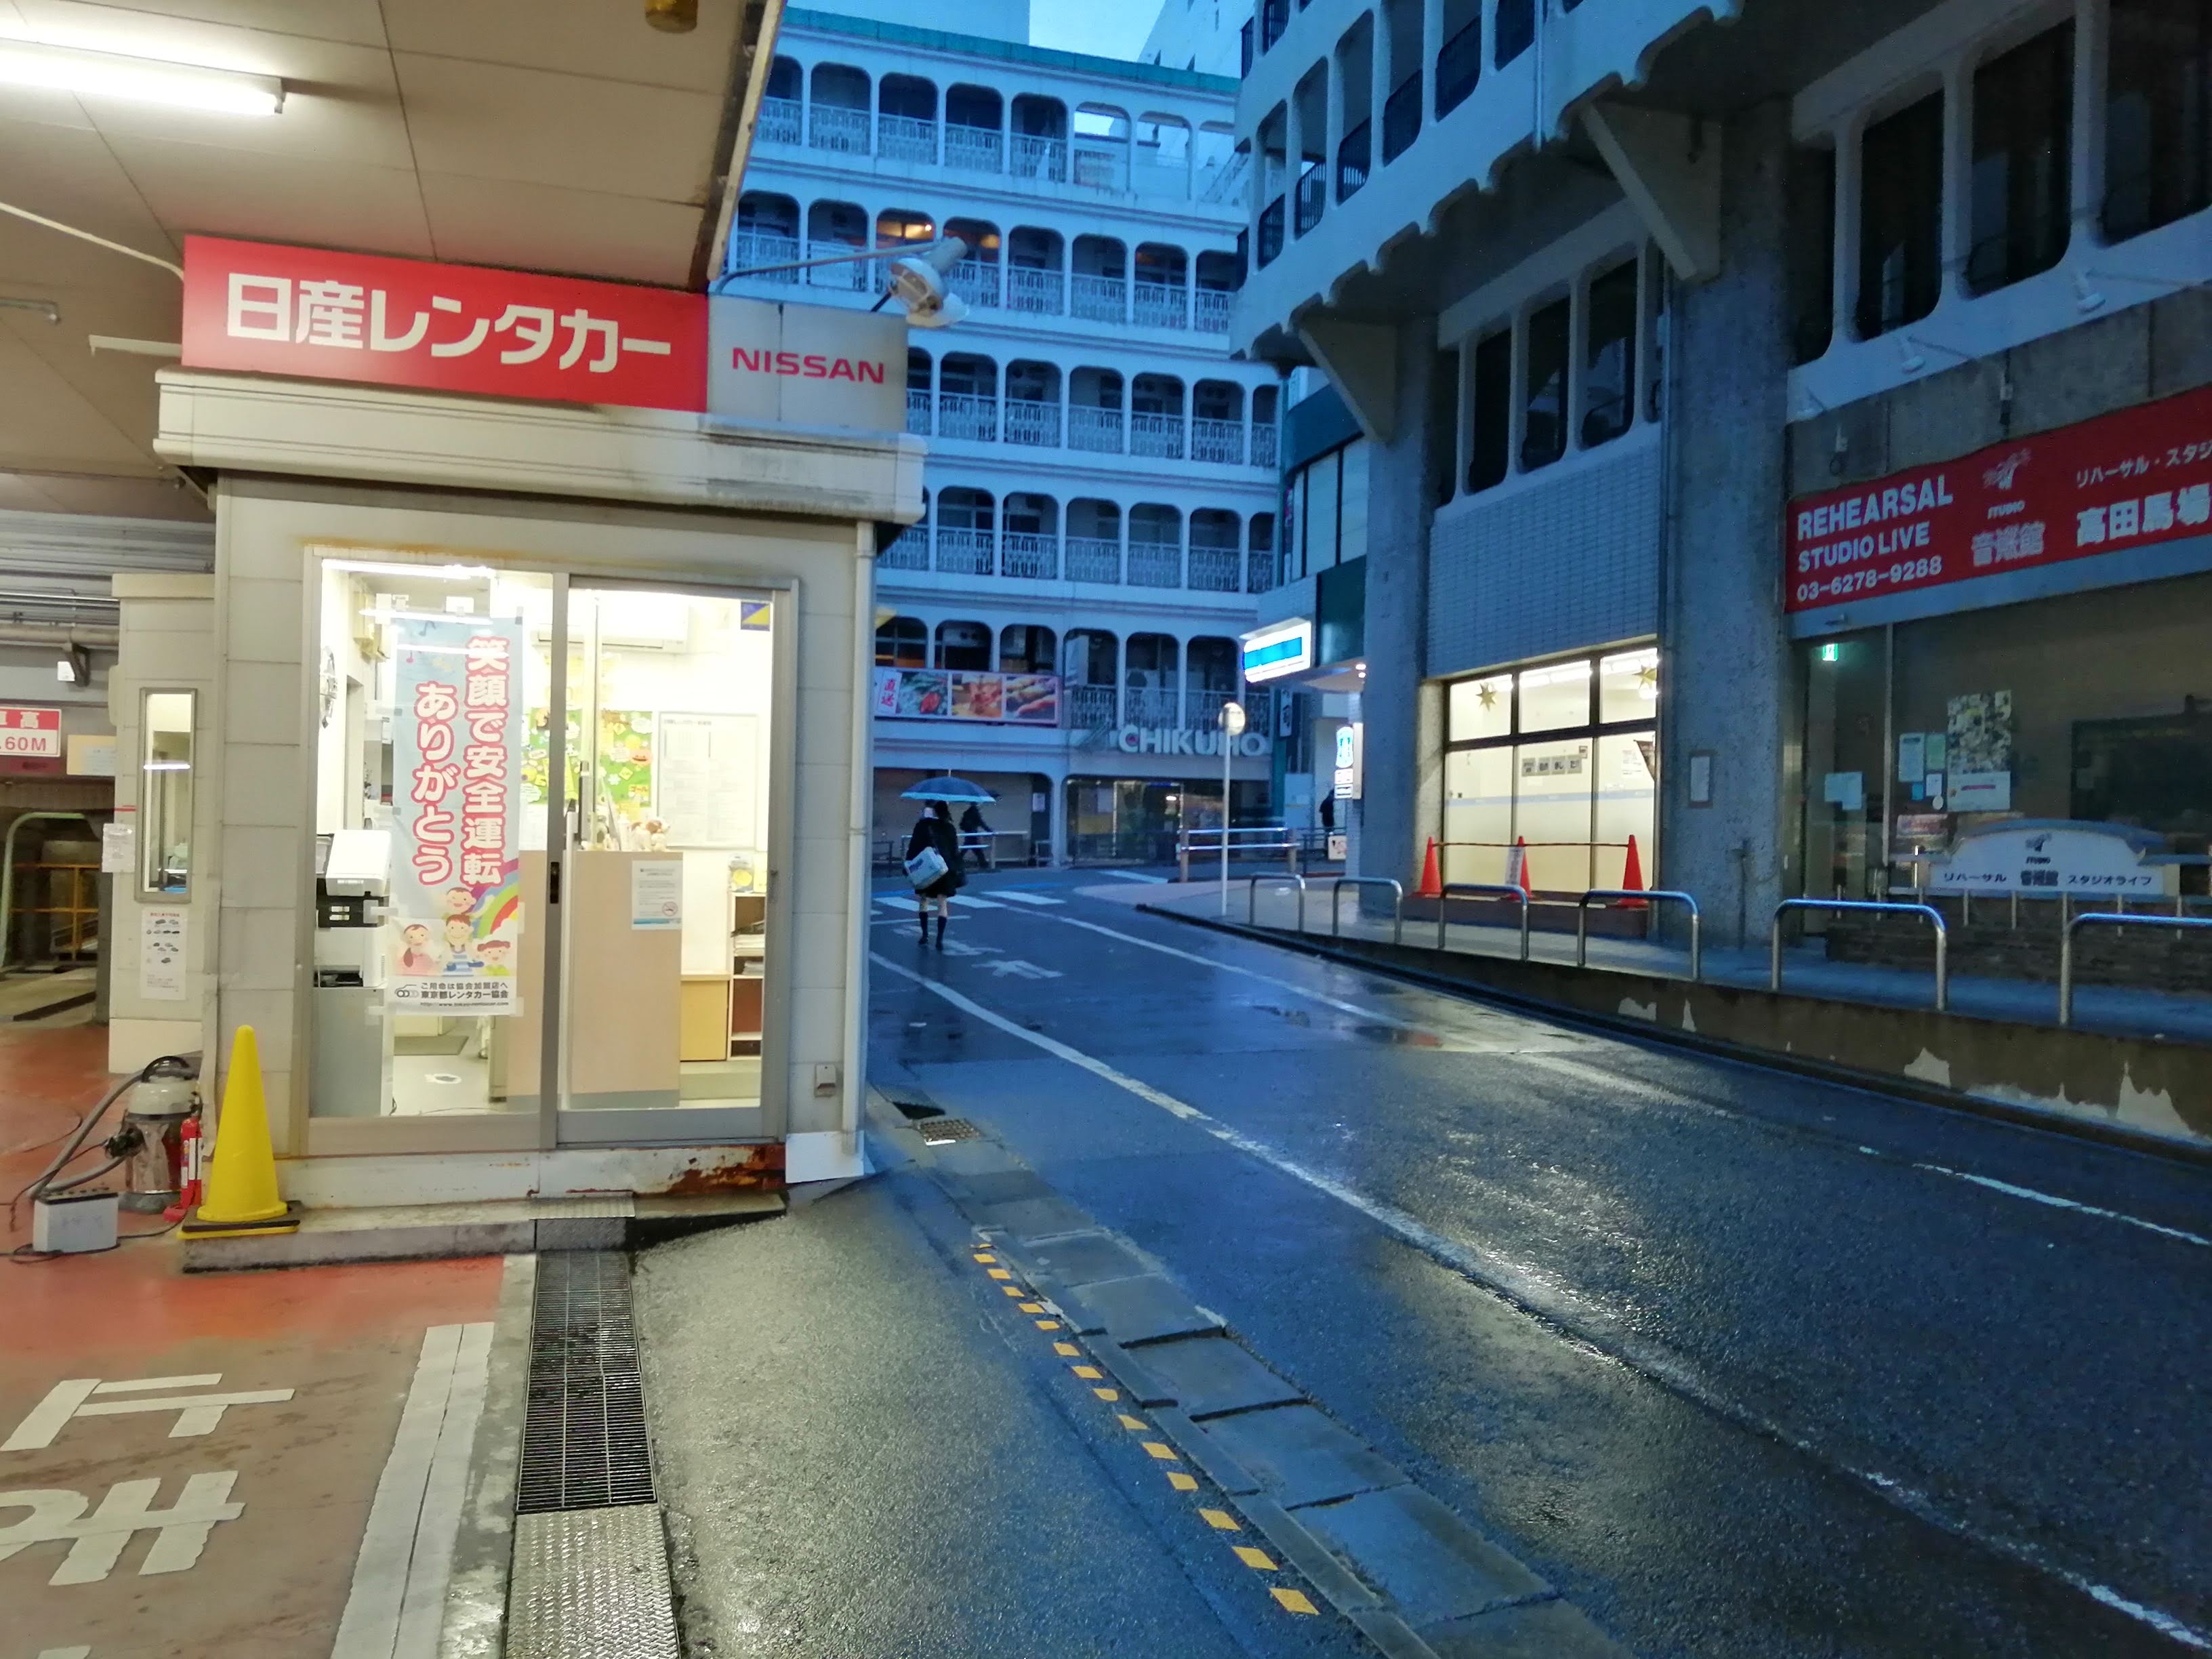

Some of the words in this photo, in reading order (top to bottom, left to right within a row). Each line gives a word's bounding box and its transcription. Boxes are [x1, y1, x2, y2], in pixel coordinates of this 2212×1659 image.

[227, 272, 671, 373] 日産レンタカー
[732, 346, 886, 384] NISSAN
[1797, 474, 1953, 541] REHEARSAL
[1798, 535, 1875, 573] STUDIO
[1878, 520, 1931, 555] LIVE
[1797, 554, 1943, 602] 03-6278-9288
[411, 680, 458, 886] ありがとう
[462, 636, 510, 887] 笑顔で安全運転
[420, 990, 509, 999] 東京都レンタカー協会
